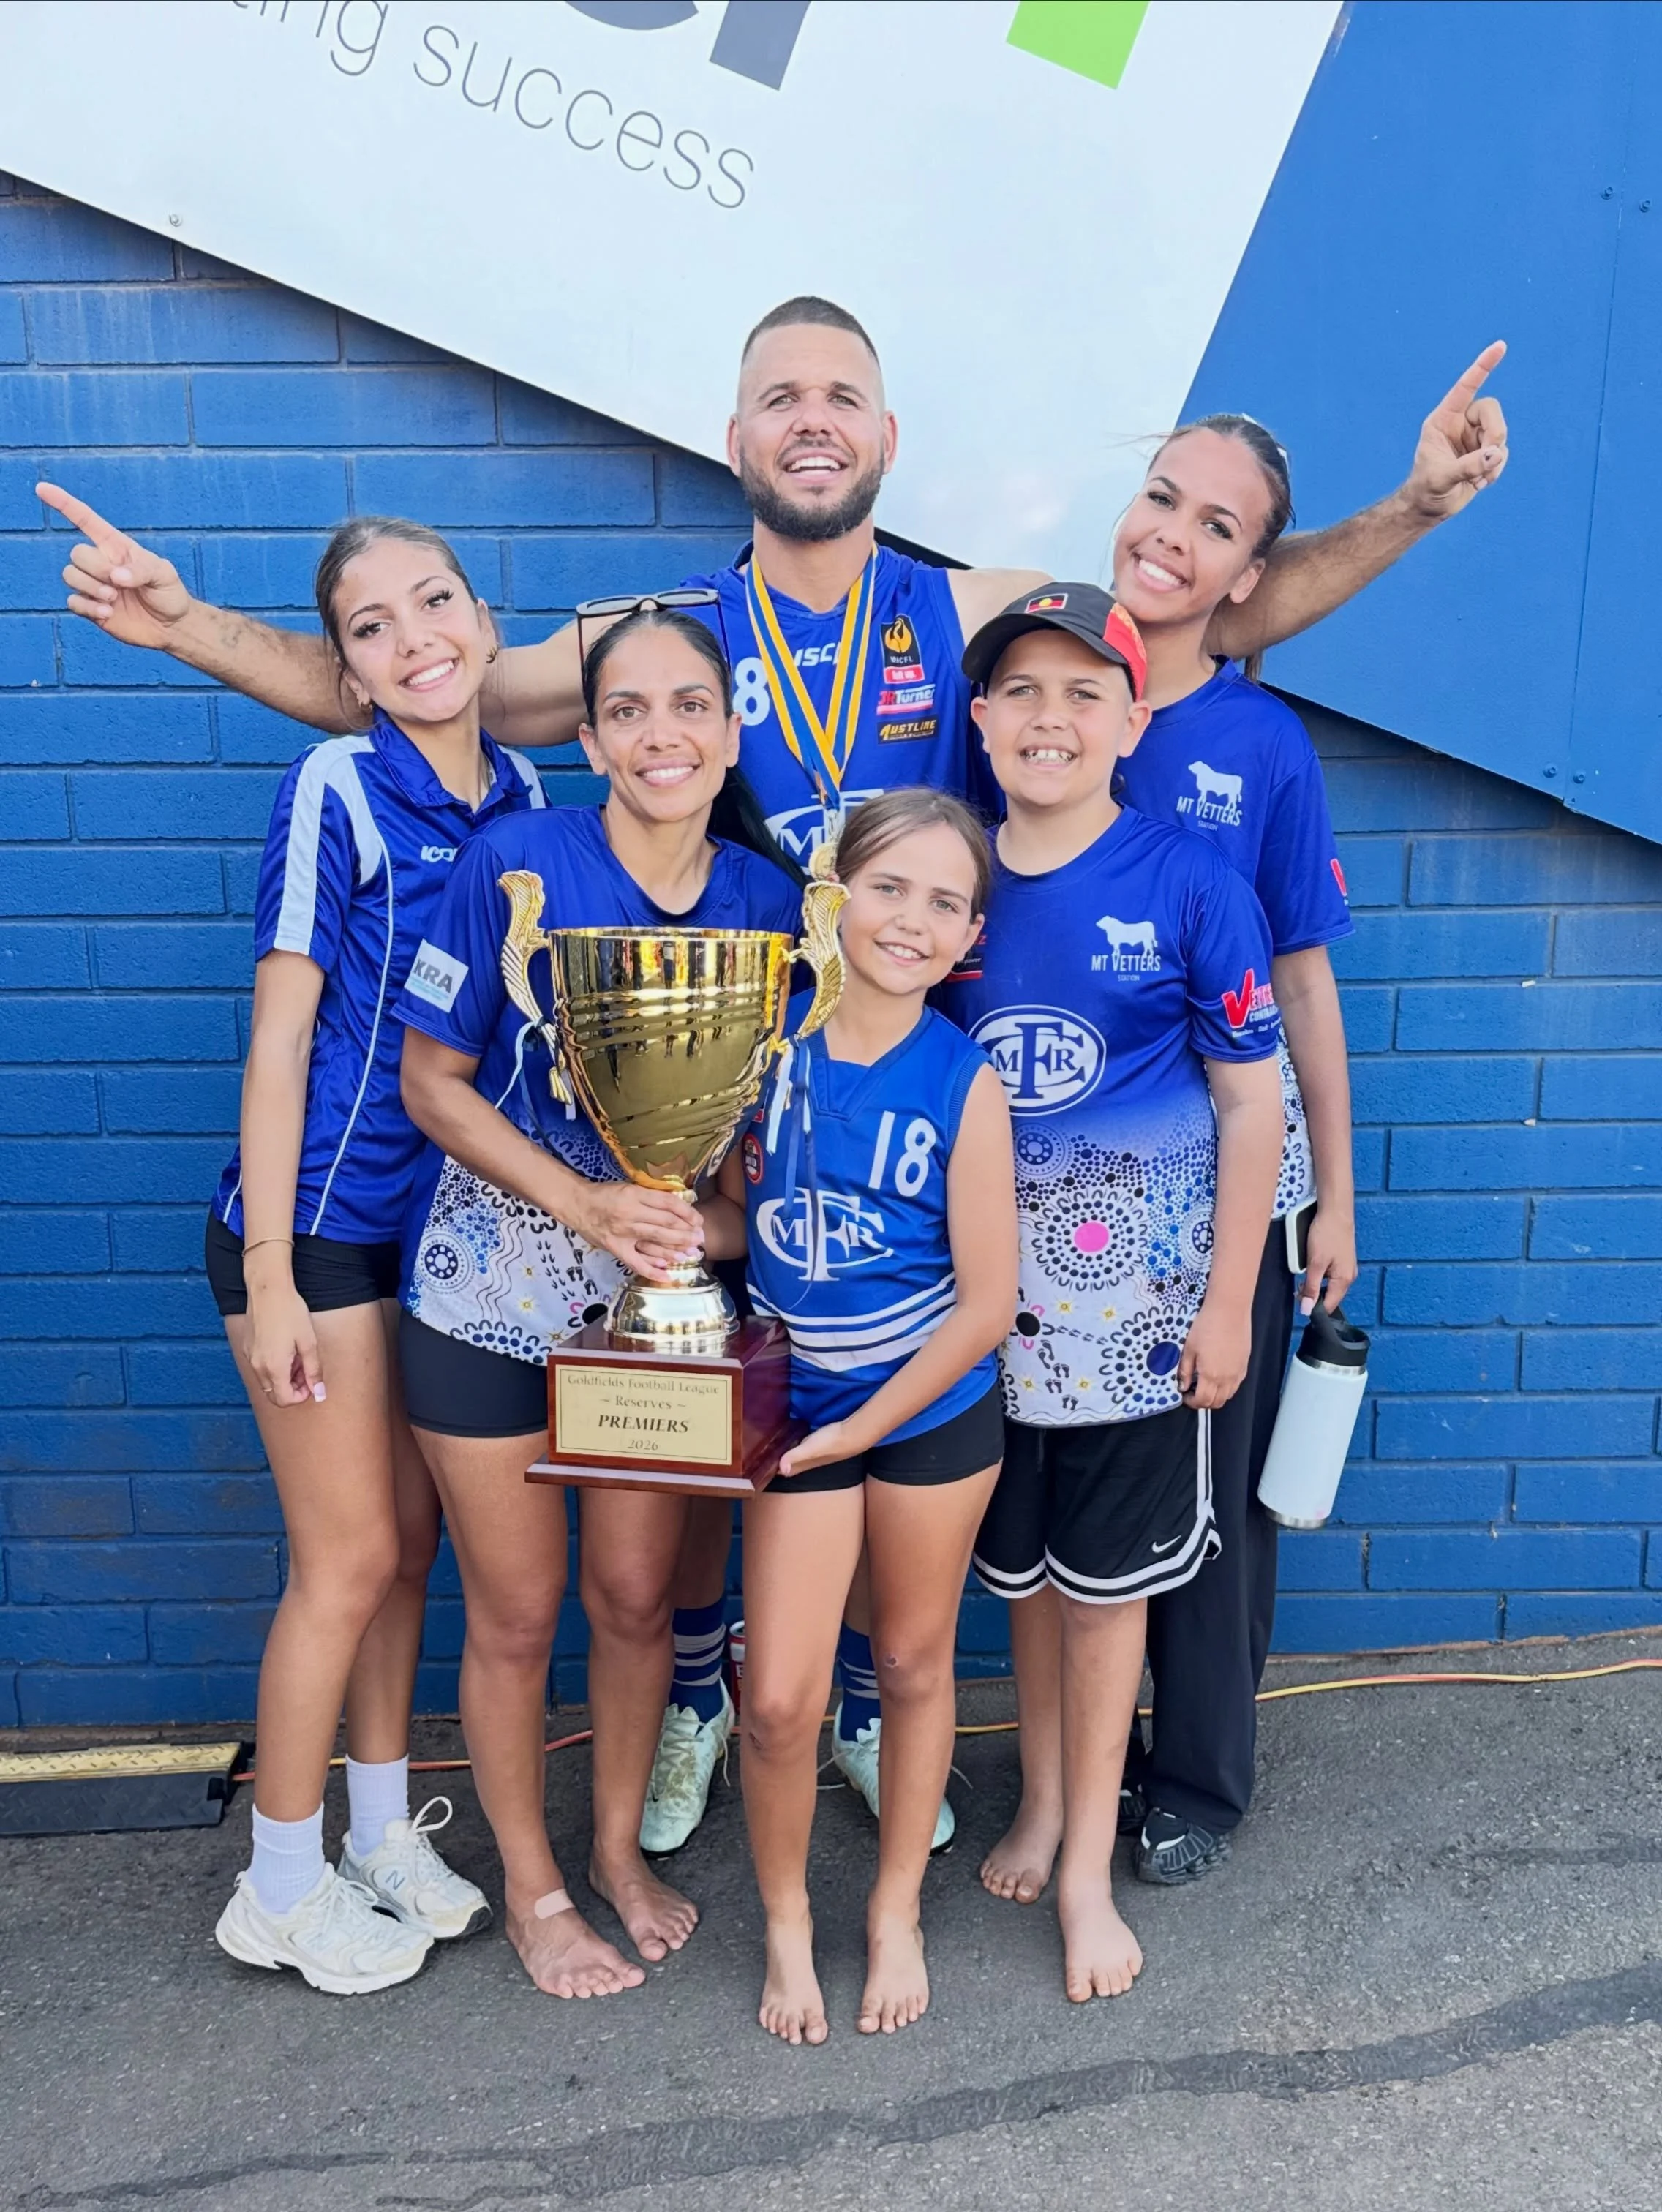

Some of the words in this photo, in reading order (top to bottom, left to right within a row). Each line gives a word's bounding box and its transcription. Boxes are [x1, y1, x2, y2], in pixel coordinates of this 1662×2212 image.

[413, 25, 753, 208] success
[1176, 795, 1195, 814] MT
[1195, 797, 1243, 827] VETTERS
[1091, 954, 1109, 972] MT
[1111, 953, 1162, 972] VETTERS
[413, 958, 453, 994] KRA
[868, 1110, 936, 1197] 18
[568, 1374, 625, 1388] Goldfields
[628, 1378, 675, 1391] Football
[679, 1382, 720, 1395] League
[615, 1395, 672, 1410] Reserves
[598, 1414, 690, 1434] PREMIERS
[628, 1439, 659, 1451] 2026
